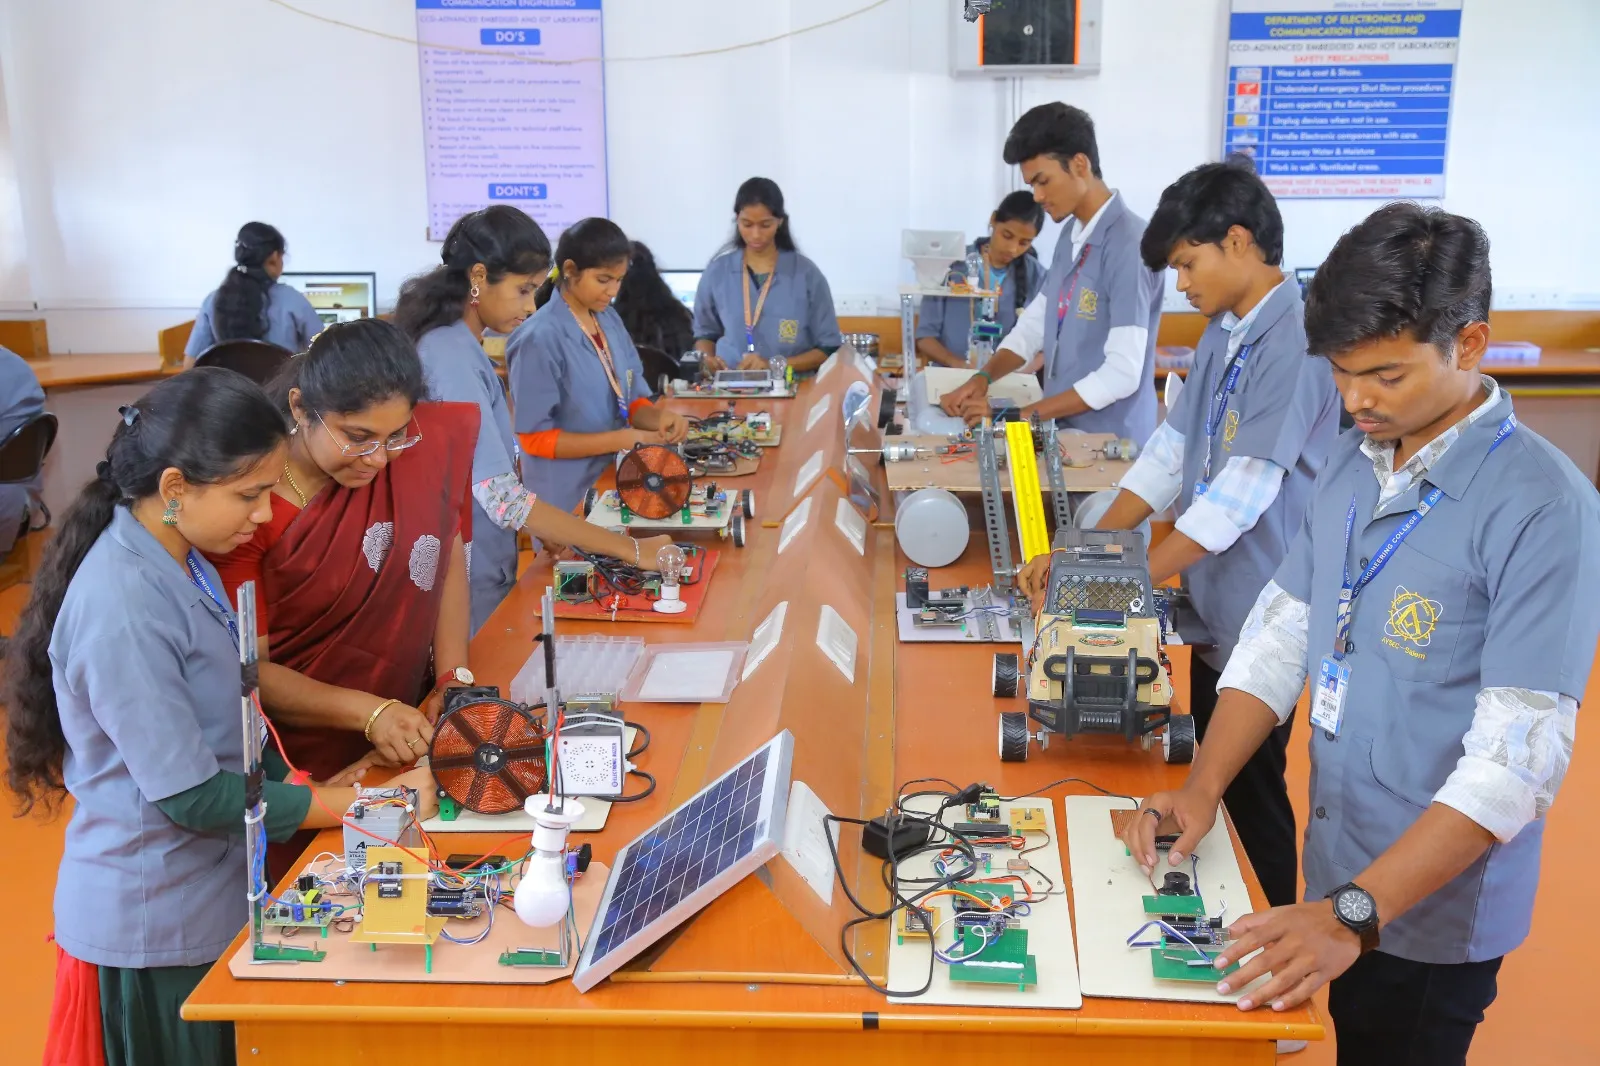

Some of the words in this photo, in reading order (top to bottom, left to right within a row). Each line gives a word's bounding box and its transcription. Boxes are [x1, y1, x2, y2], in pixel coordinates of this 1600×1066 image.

[1264, 16, 1322, 26] DEPARTMENT
[1325, 15, 1338, 25] OF
[1340, 14, 1402, 25] ELECTRONICS
[1404, 14, 1426, 24] AND
[495, 31, 526, 43] DO'S
[1270, 27, 1352, 37] COMMUNICATION
[1354, 26, 1418, 36] ENGINEERING
[1306, 43, 1354, 51] EMBEDDED
[1358, 42, 1378, 51] AND
[1380, 42, 1396, 50] IOT
[1399, 41, 1457, 50] LABORATORY
[1294, 55, 1324, 63] SAFETY
[1327, 54, 1390, 63] PRECAUTIONS
[1275, 85, 1318, 94] Understand
[1319, 85, 1360, 95] emergency
[1361, 84, 1378, 93] Shut
[1379, 84, 1401, 93] Down
[1274, 101, 1295, 110] Learn
[1297, 101, 1332, 111] operating
[1333, 100, 1346, 109] the
[1273, 117, 1299, 127] Unplug
[1300, 117, 1328, 126] devices
[1330, 116, 1350, 125] when
[1351, 116, 1365, 125] not
[1366, 116, 1374, 124] in
[1272, 132, 1298, 141] Handle
[1300, 132, 1336, 141] Electronic
[1337, 132, 1382, 142] components
[1383, 131, 1399, 140] with
[495, 186, 541, 197] DONT'S
[1361, 543, 1394, 585] ENGINEERING
[1391, 514, 1418, 544] COLLEGE
